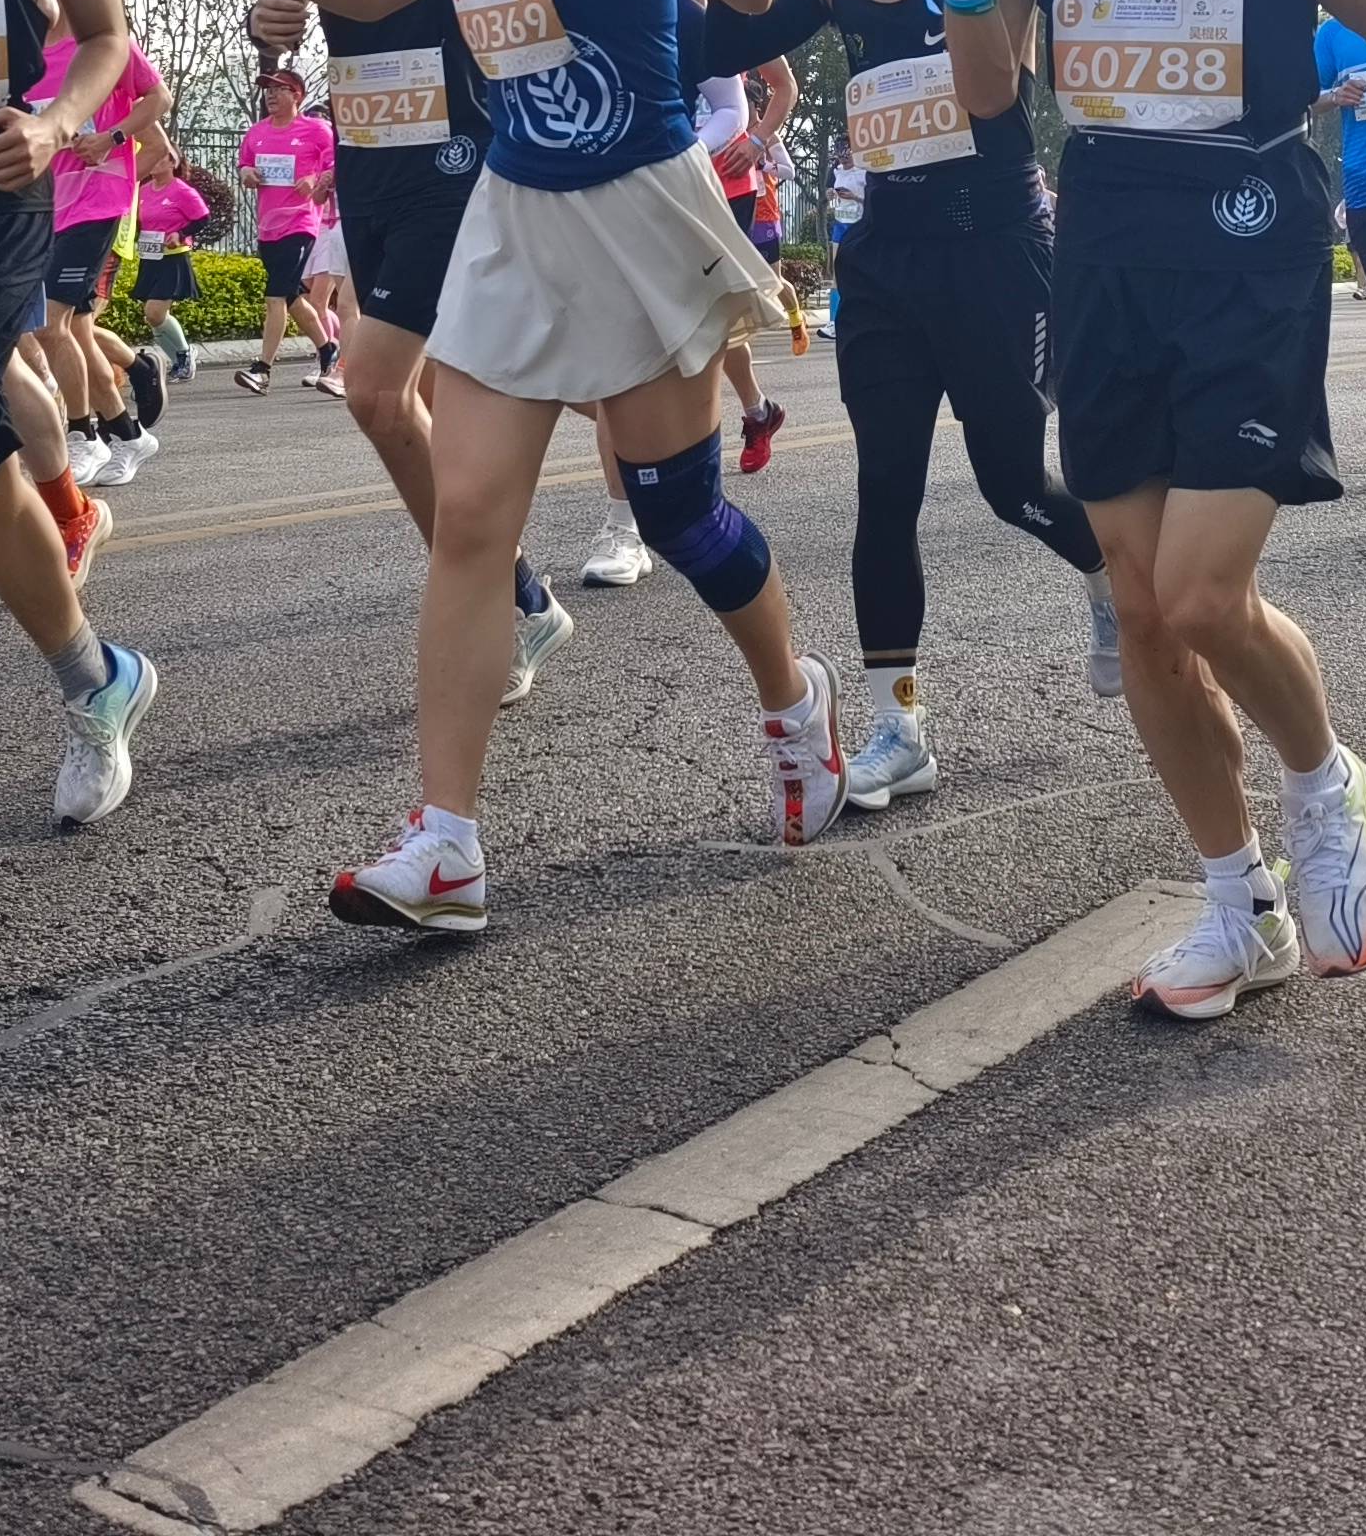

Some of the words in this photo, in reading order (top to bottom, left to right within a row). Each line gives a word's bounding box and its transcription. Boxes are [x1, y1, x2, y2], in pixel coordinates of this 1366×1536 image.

[462, 2, 548, 51] 60369
[1063, 0, 1076, 23] E
[1062, 45, 1227, 92] 60788
[336, 89, 436, 125] 60247
[599, 89, 626, 143] UNIVERSITY
[854, 99, 958, 149] 60740
